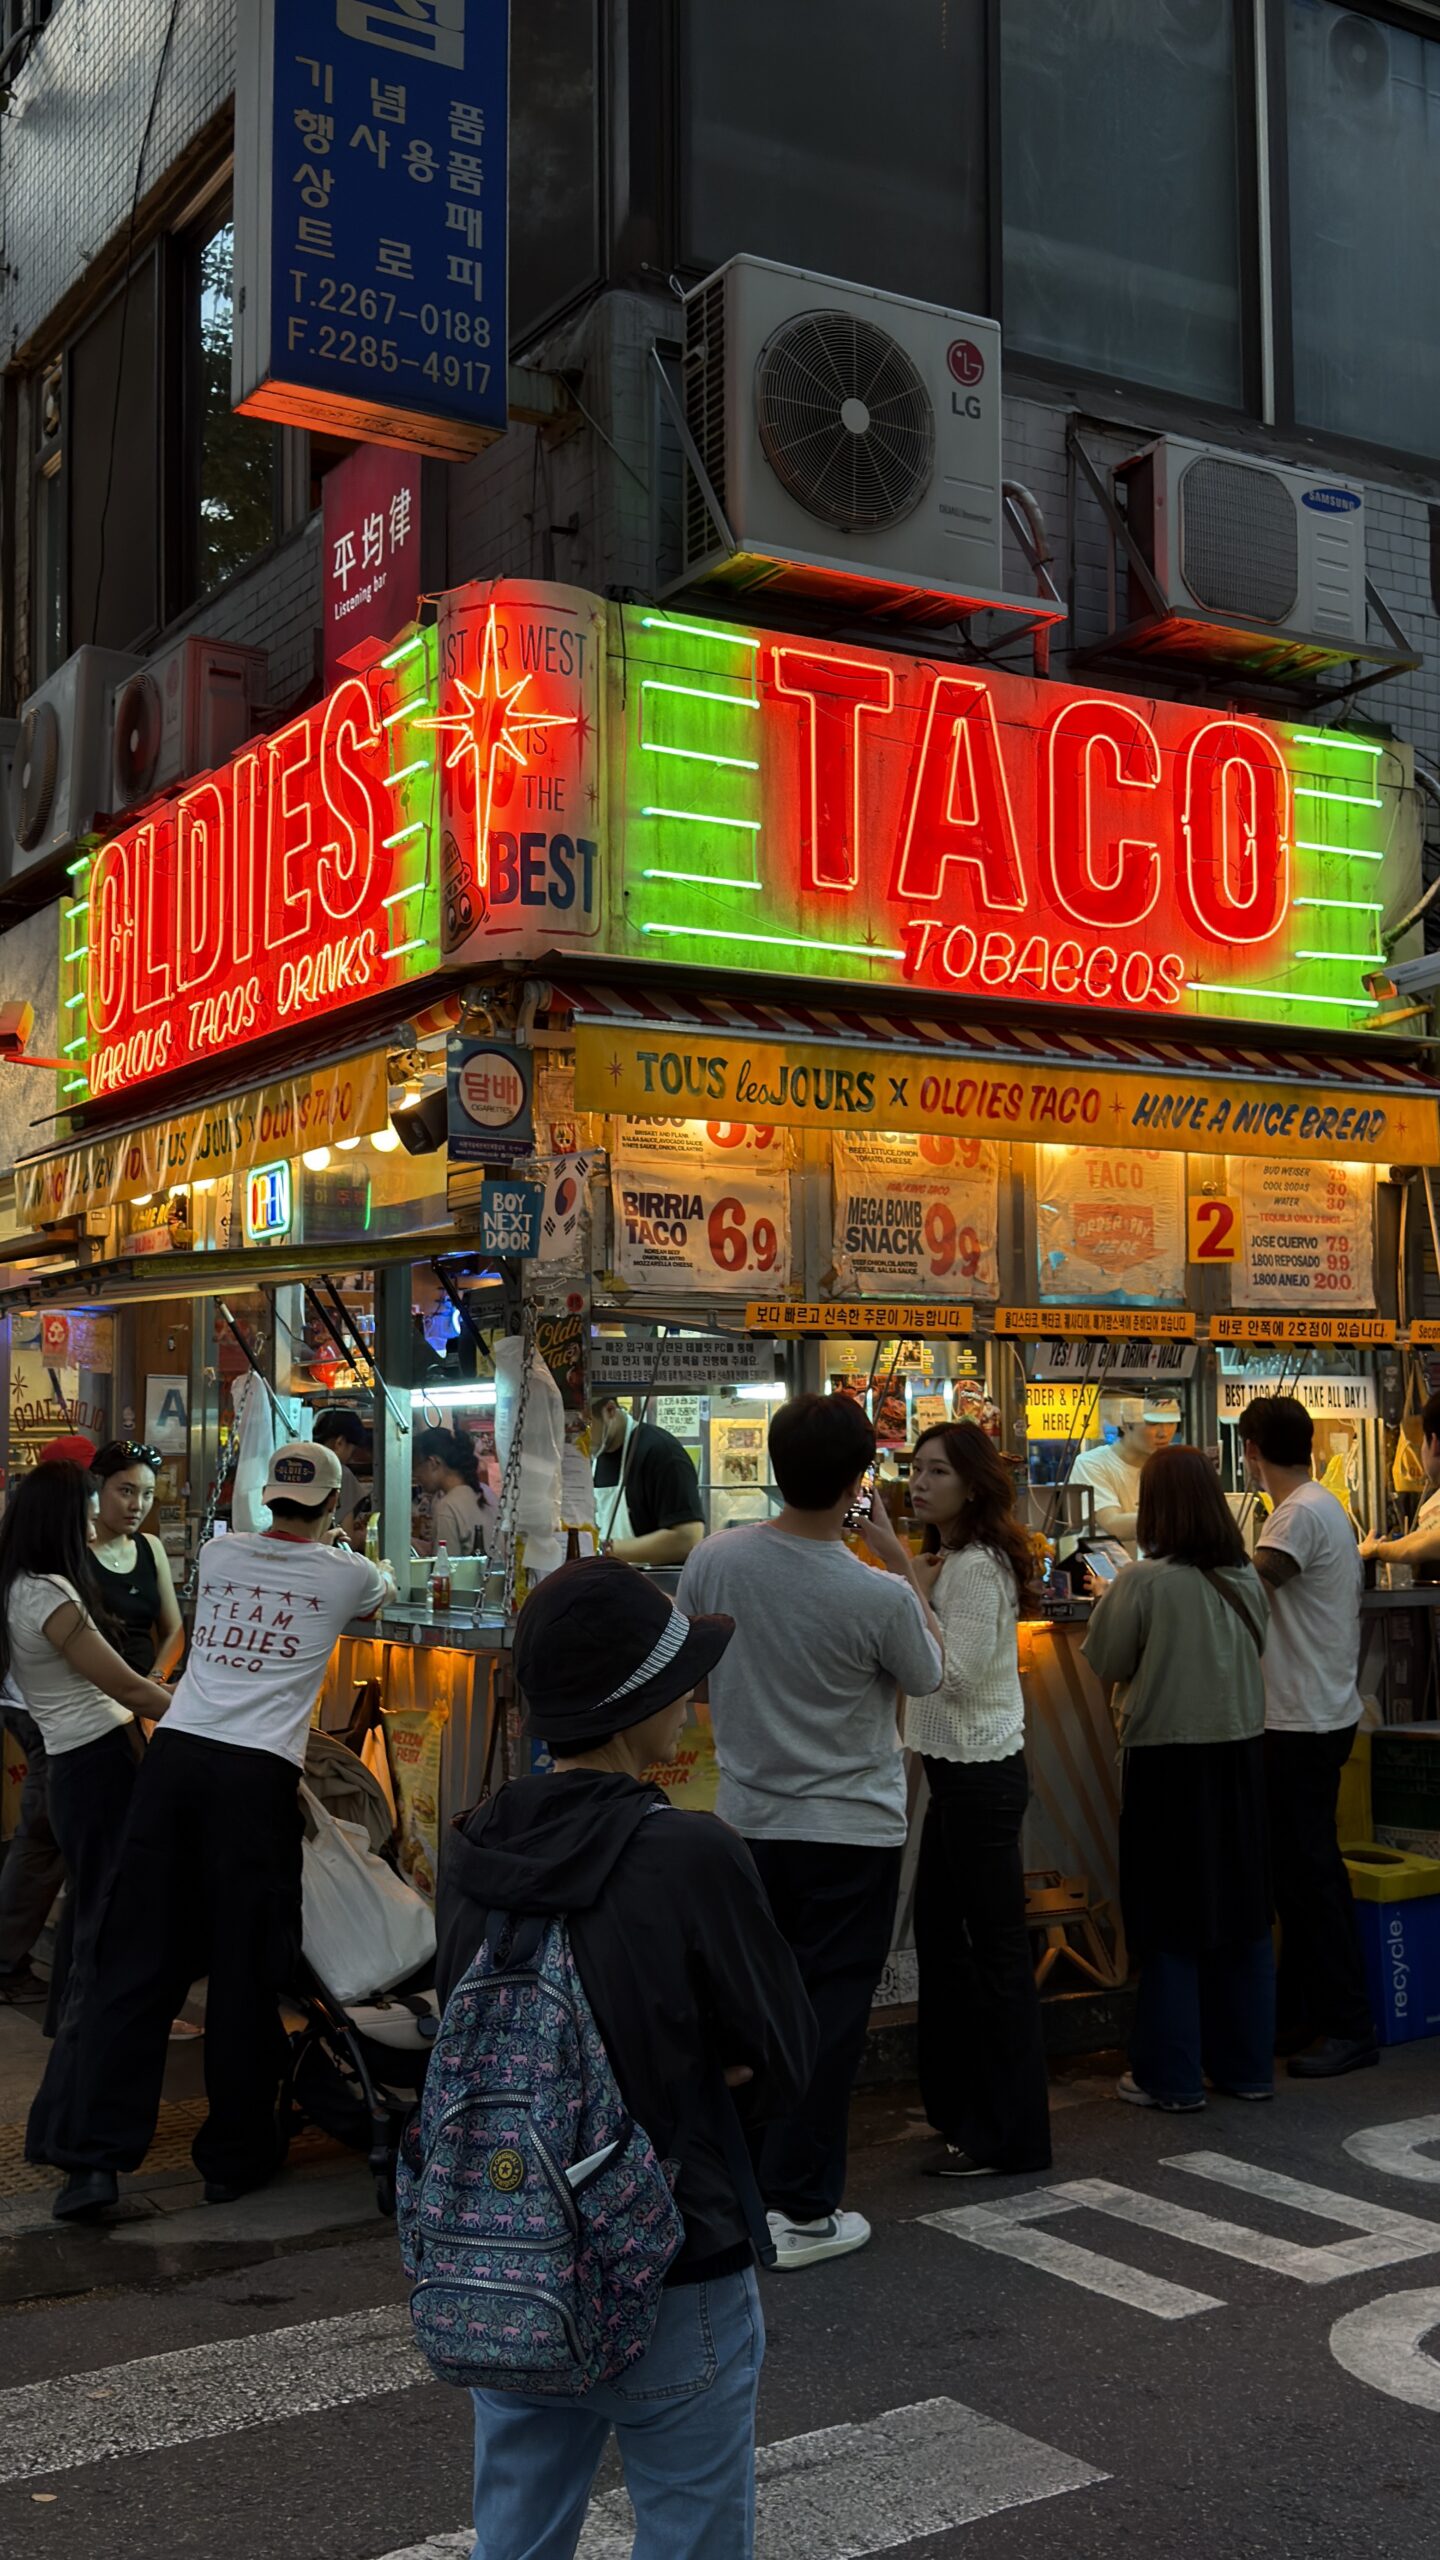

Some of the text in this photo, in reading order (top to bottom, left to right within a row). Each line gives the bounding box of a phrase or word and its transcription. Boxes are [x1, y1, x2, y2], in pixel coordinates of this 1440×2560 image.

[289, 269, 491, 348] T.2267-0188
[288, 316, 491, 394] F.2285-4917
[952, 391, 981, 419] LG
[1309, 490, 1355, 511] SAMSUNG
[333, 488, 412, 592] 平均律
[334, 572, 387, 621] Listening bar
[520, 625, 587, 680] WEST
[522, 775, 565, 812] THE
[766, 647, 1290, 944] TACO
[88, 680, 384, 1034] OLDIES
[490, 831, 598, 914] BEST
[908, 919, 1185, 1004] TOBACCOS
[90, 929, 378, 1095] VARIOUS TACOS DRINKS
[463, 1072, 518, 1106] 담배
[637, 1051, 728, 1099] TOUS
[767, 1066, 876, 1113] JOURS
[919, 1075, 1023, 1121] OLDIES
[1029, 1084, 1100, 1124] TACO
[1132, 1092, 1388, 1144] HAVE A NICE BREAD
[1084, 1160, 1144, 1189] TACO
[251, 1171, 289, 1232] OPEN
[493, 1192, 526, 1213] BOY
[483, 1212, 533, 1231] NEXT
[622, 1191, 777, 1272] BIRRIA 6.9
[625, 1219, 687, 1247] TACO
[848, 1197, 981, 1277] MEGA BOMB 9.9
[1197, 1202, 1235, 1258] 2
[486, 1230, 530, 1250] DOOR
[845, 1227, 924, 1255] SNACK
[1251, 1236, 1275, 1247] JOSE
[1277, 1237, 1318, 1249] CUERVO
[1275, 1255, 1320, 1267] REPOSADO
[756, 1307, 962, 1327] 보다 빠르고 신속한 주문이 가능합니다.
[1219, 1320, 1242, 1335] 바로
[1248, 1321, 1283, 1336] 안쪽에
[1288, 1322, 1332, 1337] 2호점이
[1121, 1345, 1149, 1368] DRINK
[1157, 1345, 1186, 1369] WALK
[156, 1389, 188, 1427] A
[1026, 1388, 1055, 1406] RDER
[1225, 1385, 1246, 1407] BEST
[1304, 1387, 1324, 1408] TAKE
[1327, 1387, 1342, 1408] ALL
[1042, 1414, 1070, 1431] HERE
[213, 1602, 293, 1630] TEAM
[194, 1625, 300, 1658] OLDIES
